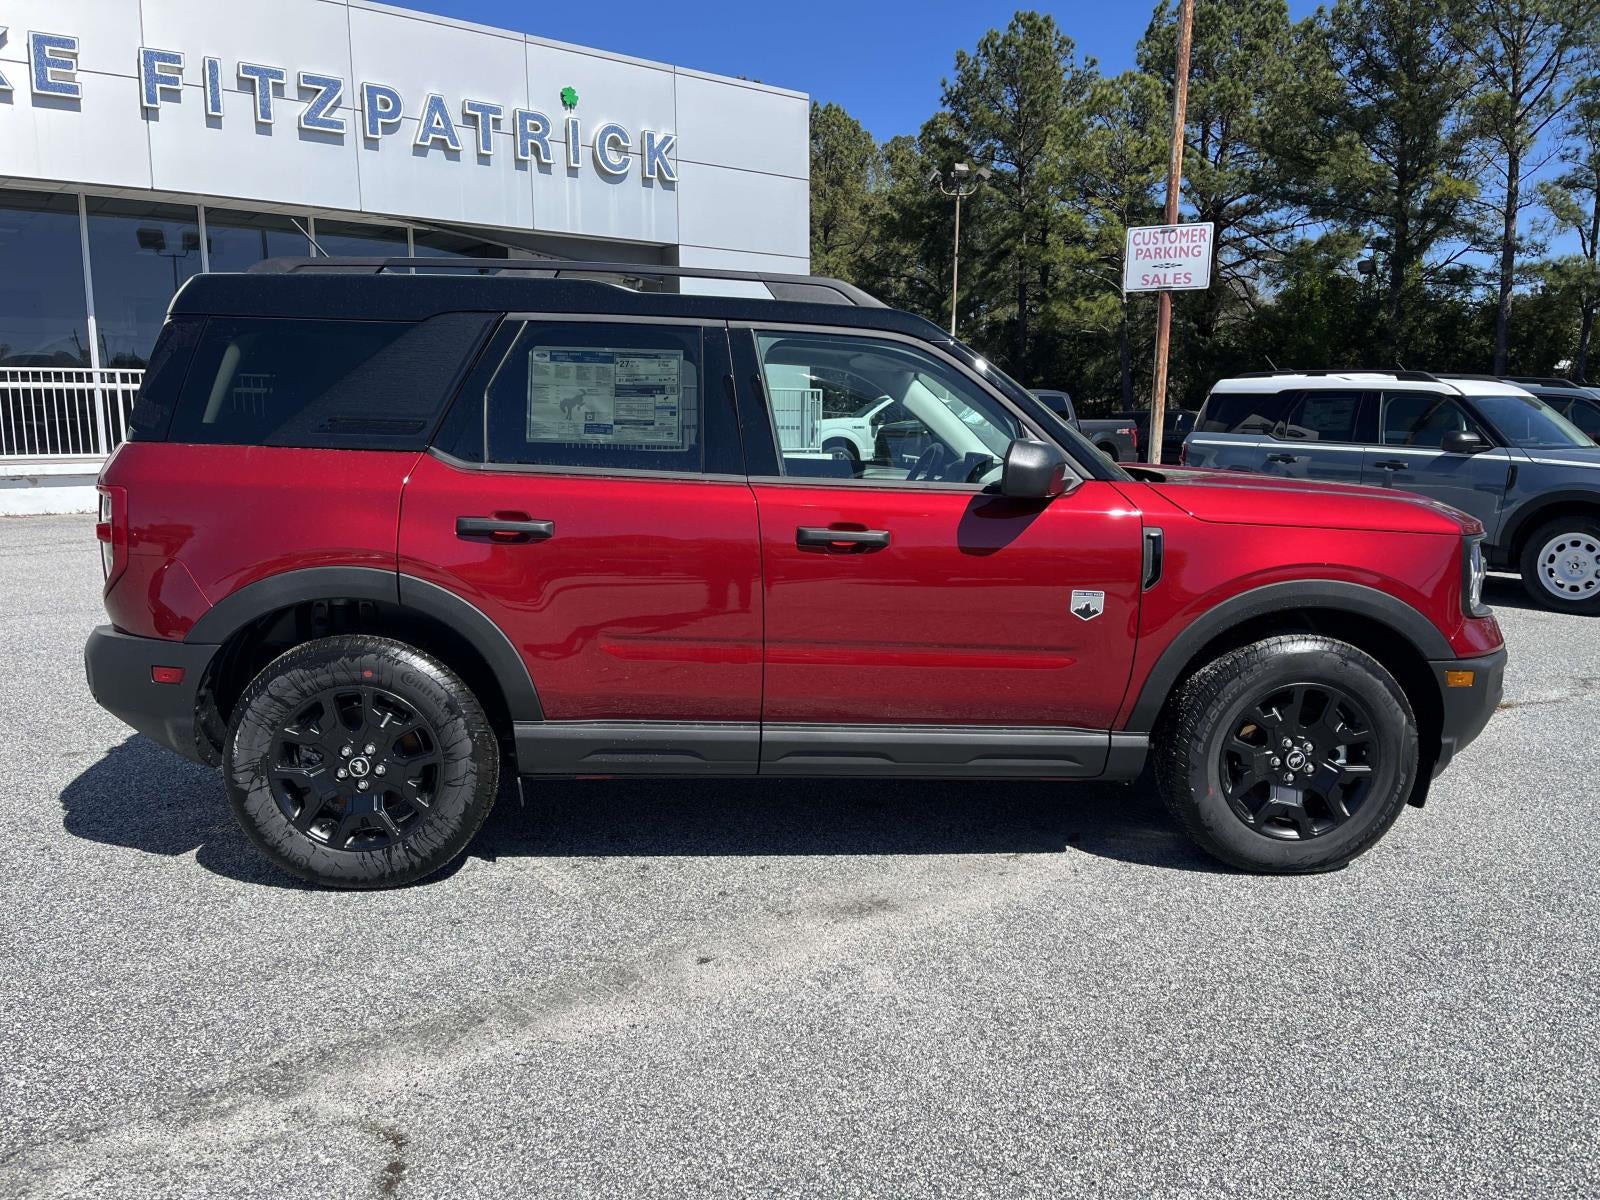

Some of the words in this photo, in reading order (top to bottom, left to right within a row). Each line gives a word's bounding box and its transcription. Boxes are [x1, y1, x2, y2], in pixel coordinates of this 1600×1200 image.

[137, 47, 679, 182] FITZPATRICK
[1132, 228, 1207, 246] CUSTOMER
[1135, 245, 1202, 260] PARKING
[1141, 272, 1192, 286] SALES
[619, 360, 630, 368] 27
